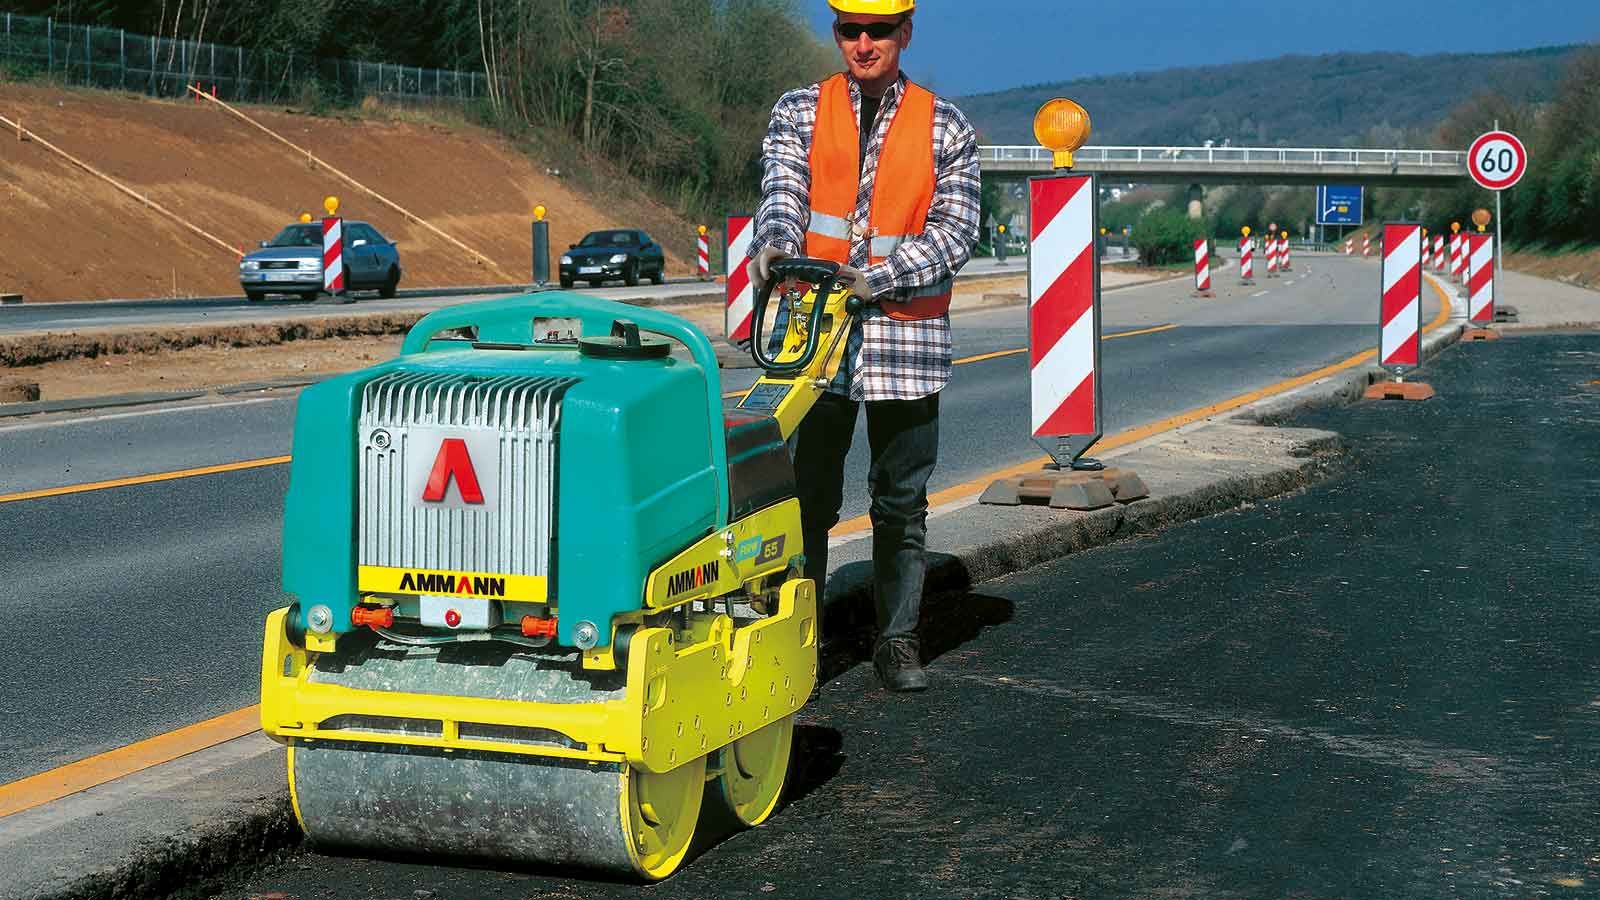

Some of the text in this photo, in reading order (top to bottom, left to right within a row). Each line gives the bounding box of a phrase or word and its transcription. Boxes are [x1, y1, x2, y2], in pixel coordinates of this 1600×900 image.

[1481, 148, 1512, 172] 60
[764, 541, 778, 558] 65
[400, 572, 505, 596] AMMANN
[667, 560, 719, 598] AMMANN
